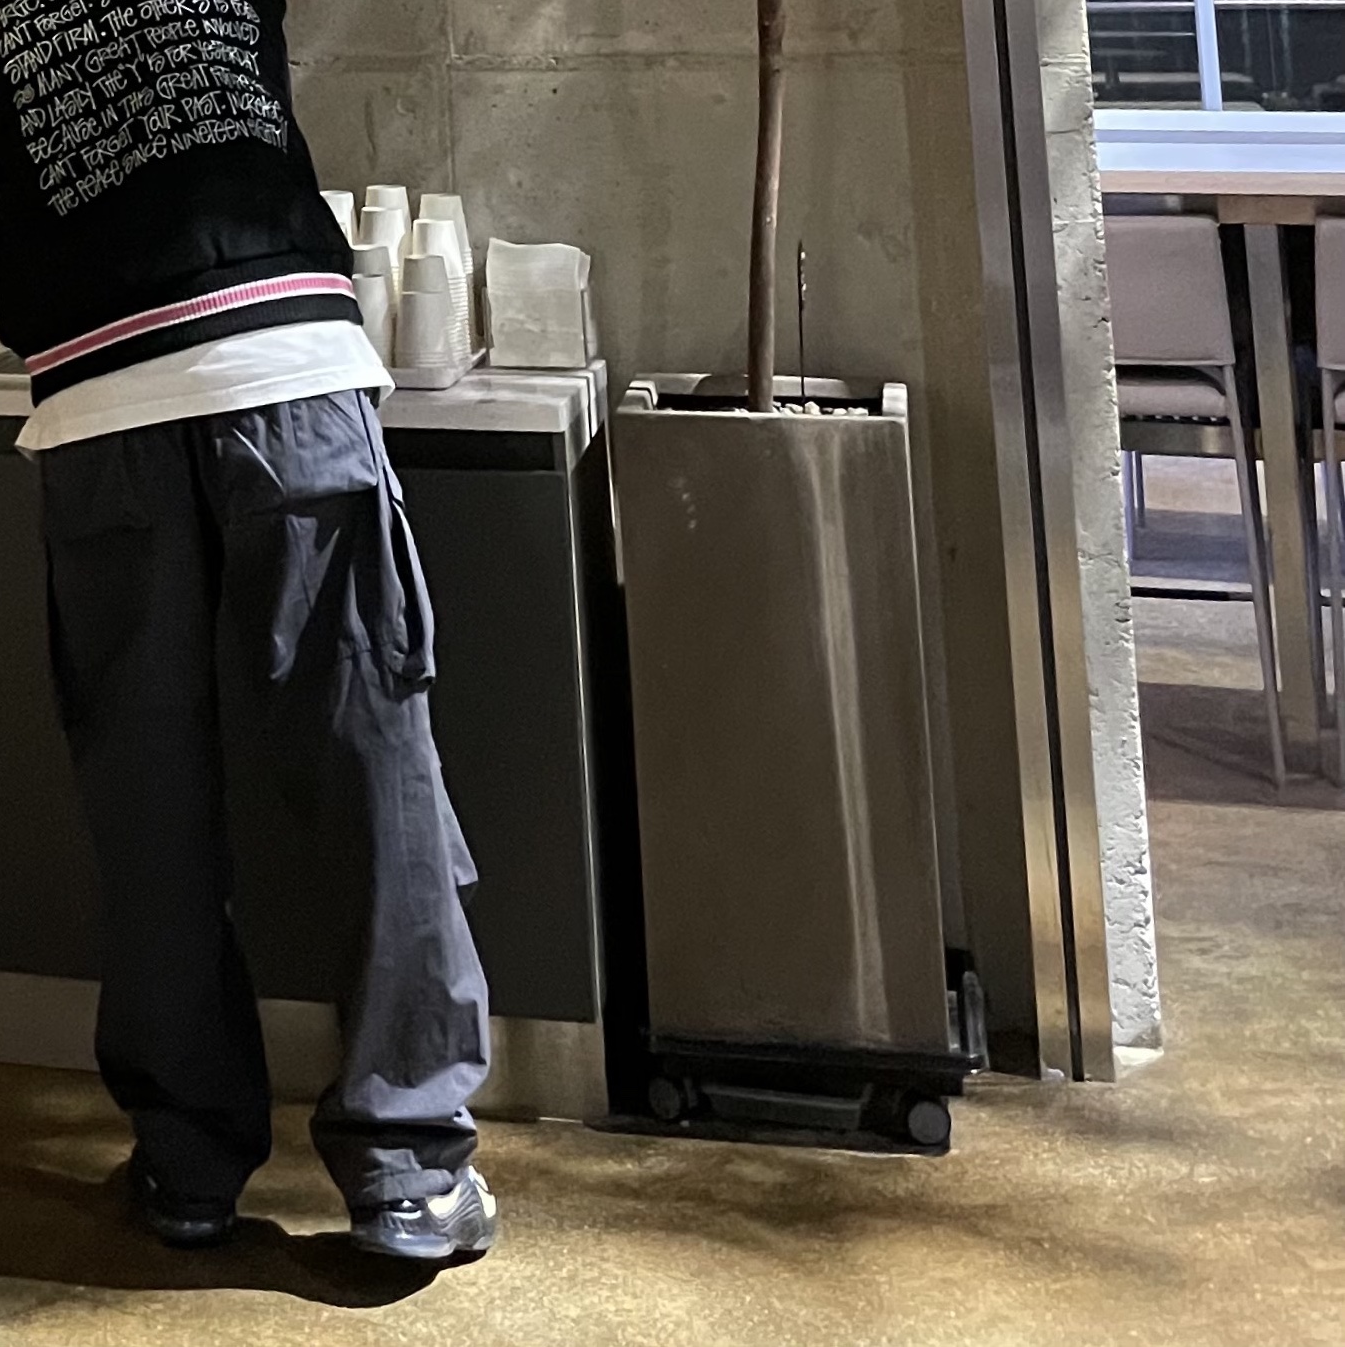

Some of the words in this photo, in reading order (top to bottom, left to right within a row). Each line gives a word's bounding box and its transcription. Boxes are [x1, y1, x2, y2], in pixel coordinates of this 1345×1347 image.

[3, 40, 53, 85] STAND
[99, 5, 138, 38] THE
[36, 54, 83, 97] MANY
[85, 30, 144, 73] GREAT
[143, 18, 200, 49] PEOPLE
[19, 107, 46, 138] AND
[92, 69, 128, 99] THE
[163, 43, 198, 69] FOR
[25, 116, 103, 164] BECAUSE
[100, 103, 119, 129] IN
[155, 63, 211, 100] GREAT
[137, 104, 183, 140] YOUR
[47, 186, 80, 217] THE
[75, 158, 124, 203] PEACE
[169, 117, 250, 154] NINETEEN
